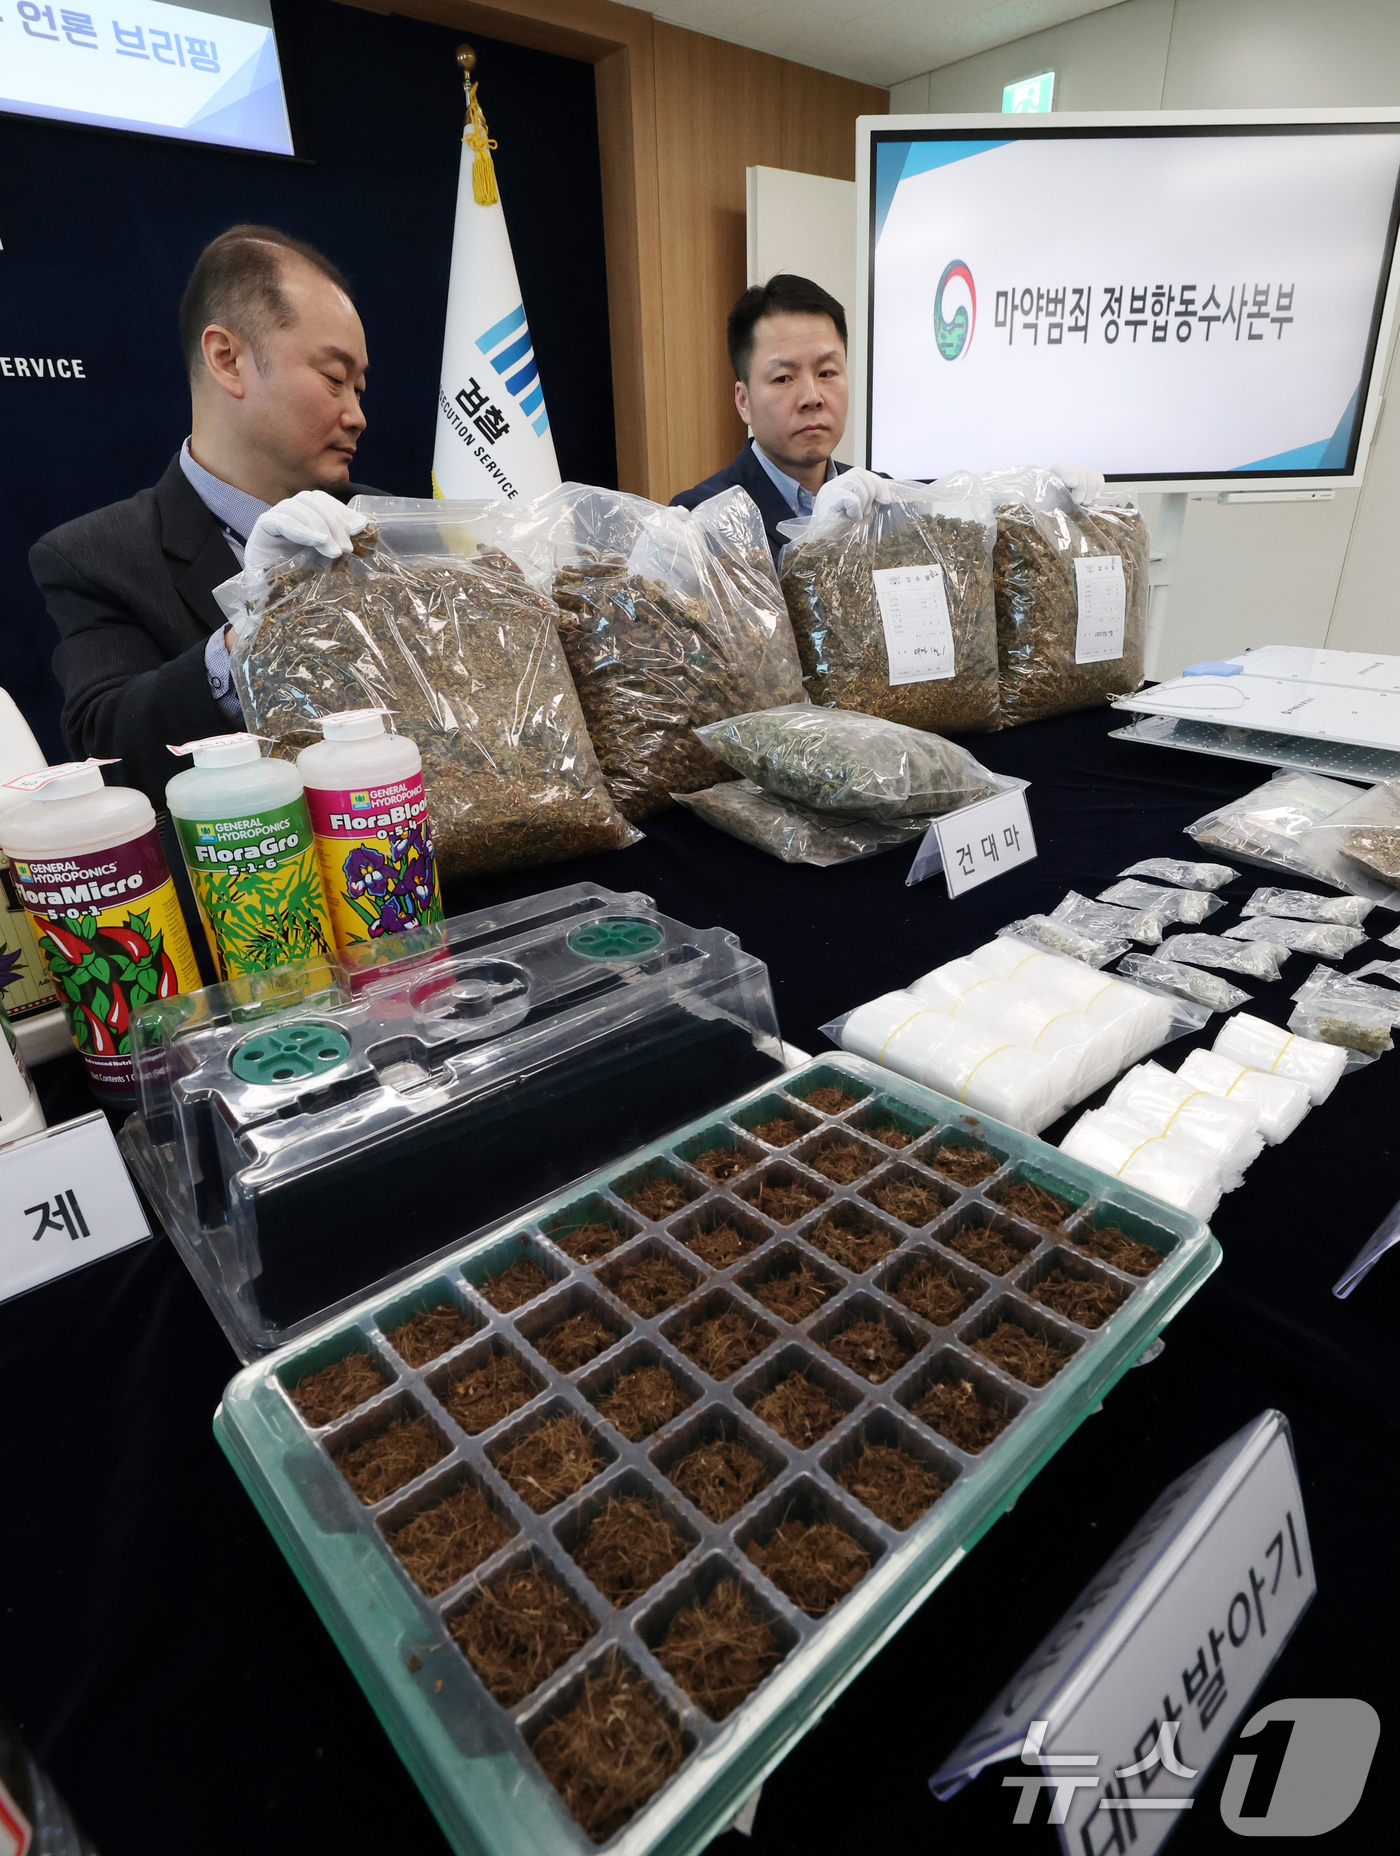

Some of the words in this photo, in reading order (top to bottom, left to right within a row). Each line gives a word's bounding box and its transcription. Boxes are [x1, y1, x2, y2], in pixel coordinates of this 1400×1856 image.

[17, 0, 98, 49] 언론
[112, 20, 221, 74] 브리핑
[994, 286, 1091, 346] 마약범죄
[1100, 283, 1295, 345] 정부합동수사본부
[455, 377, 510, 445] 검찰
[474, 447, 518, 500] SERVICE
[370, 783, 407, 799] GENERAL
[371, 784, 423, 808] HYDROPONICS
[215, 817, 263, 833] GENERAL
[217, 819, 291, 842] HYDROPONICS
[195, 833, 298, 863] FloraGro
[30, 861, 80, 874] GENERAL
[33, 863, 117, 883] HYDROPONICS
[228, 858, 277, 876] 2-1-6
[47, 905, 102, 920] 5-0-1
[99, 1073, 125, 1083] Contents
[24, 1189, 90, 1241] 제
[1081, 1511, 1303, 1856] 대마발아기
